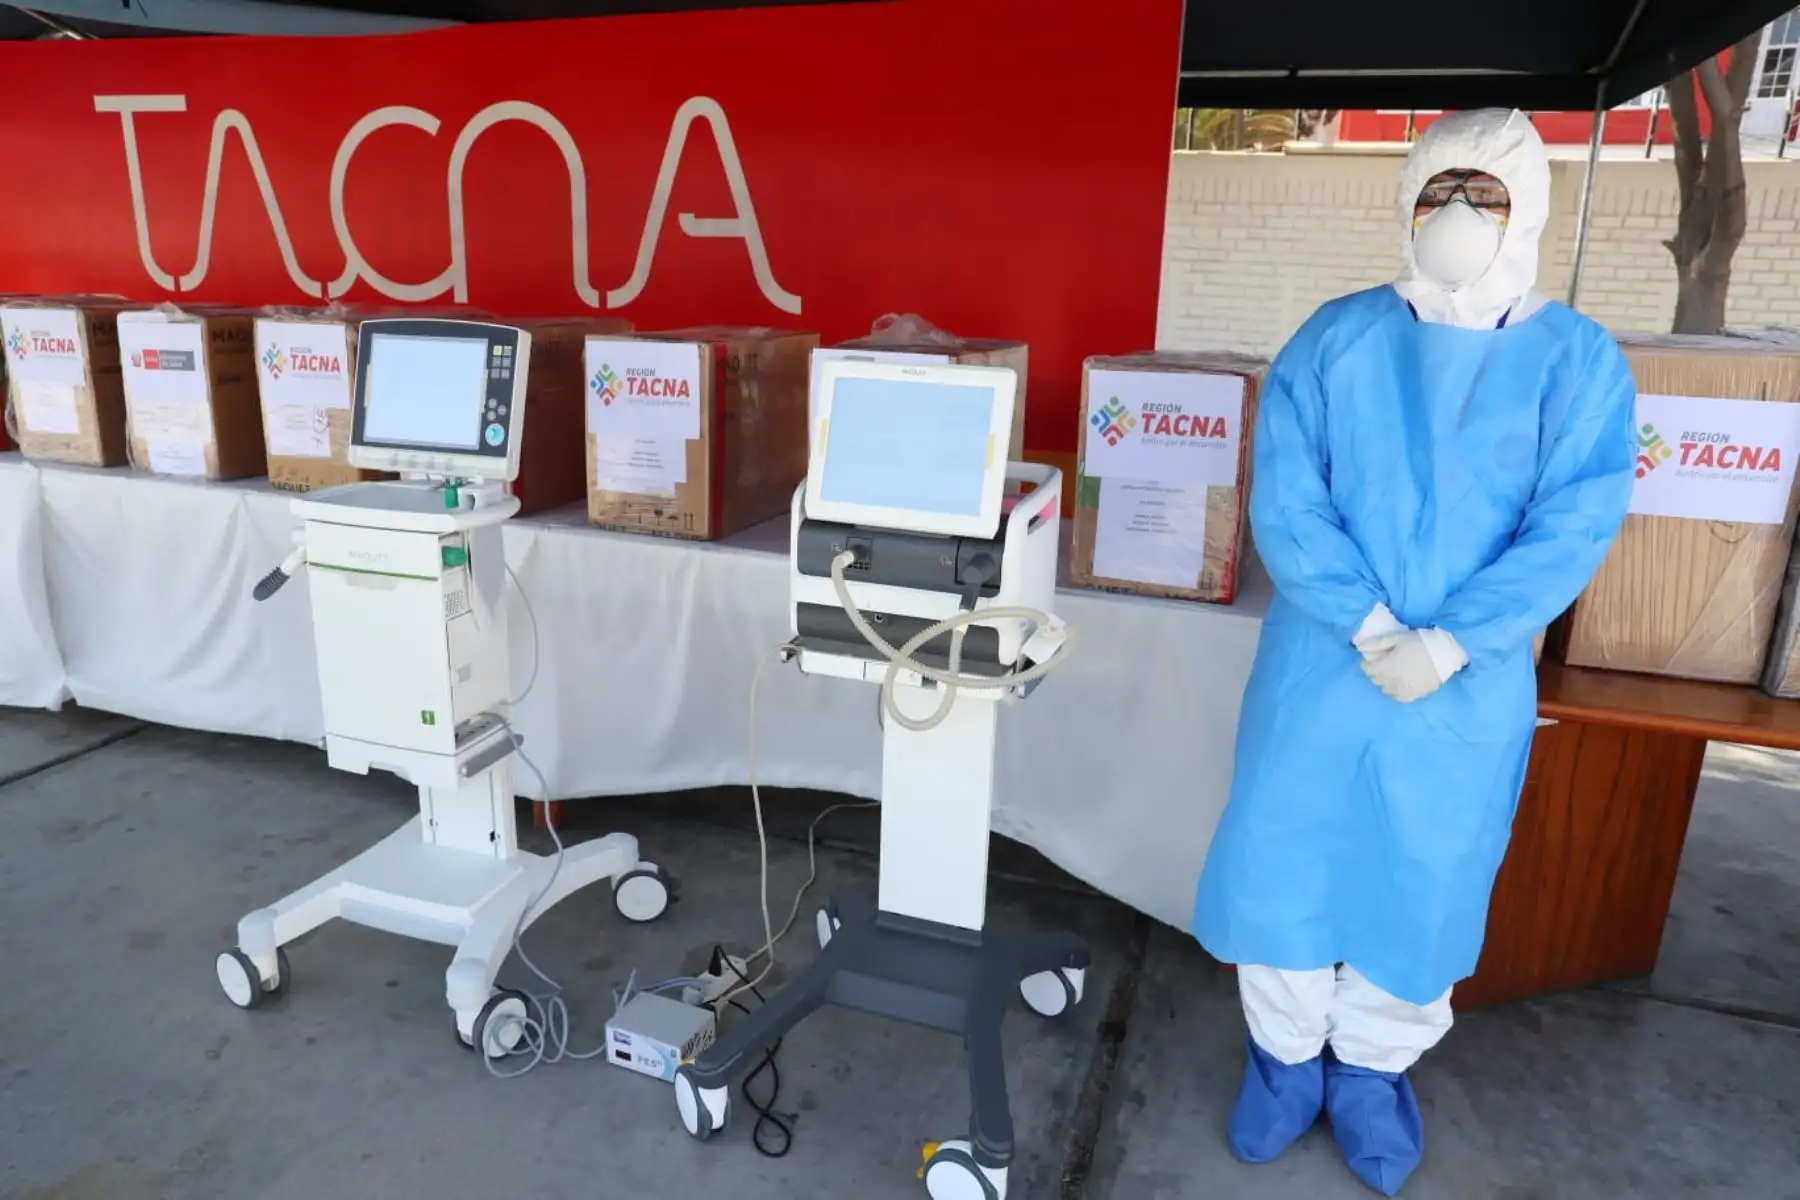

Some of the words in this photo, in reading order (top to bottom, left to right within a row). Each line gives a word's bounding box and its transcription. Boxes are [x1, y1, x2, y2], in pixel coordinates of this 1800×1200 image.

[94, 95, 802, 314] TACNA
[31, 337, 76, 354] TACNA
[290, 354, 341, 372] TACNA
[627, 377, 690, 398] TACNA
[1142, 413, 1227, 438] TACNA
[1680, 442, 1781, 471] TACNA
